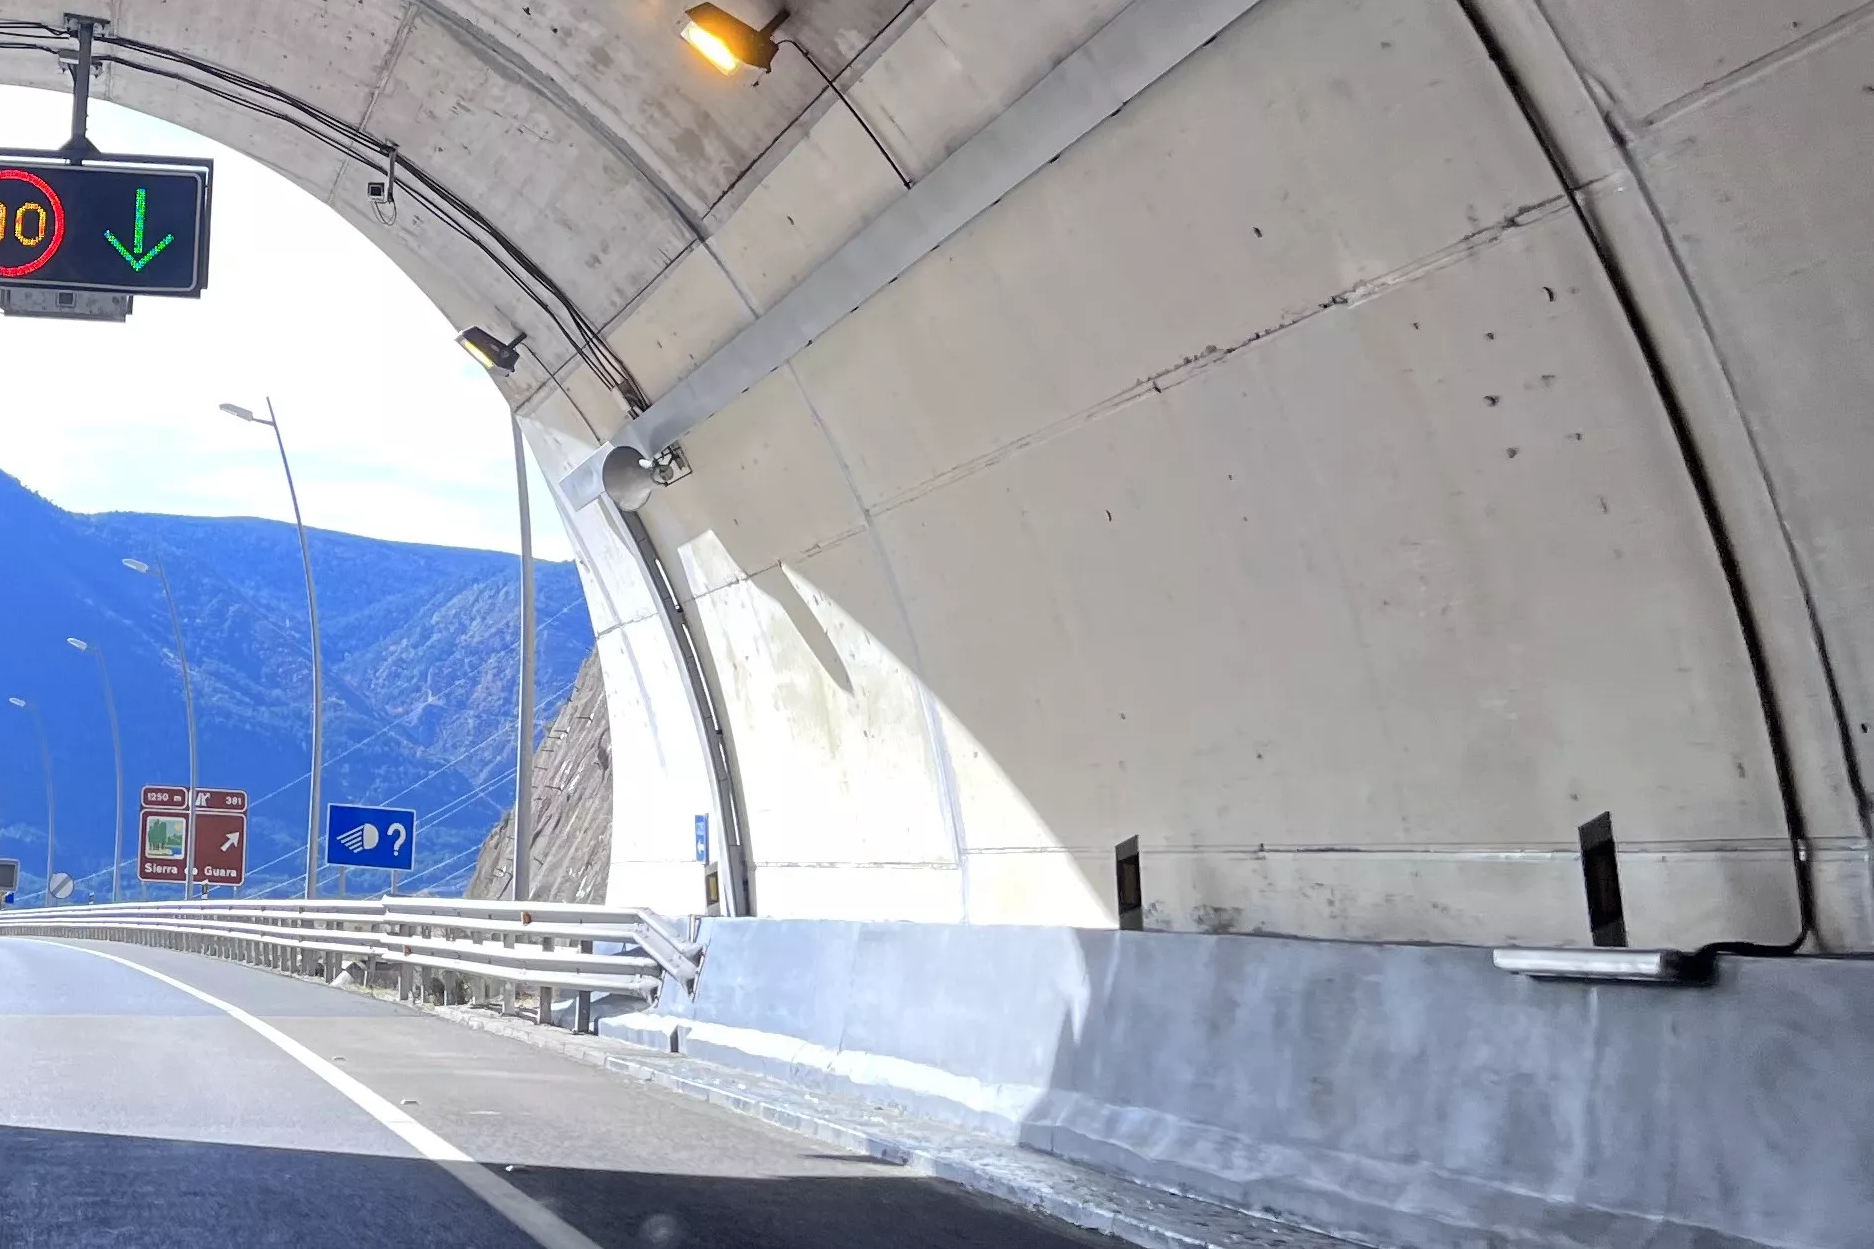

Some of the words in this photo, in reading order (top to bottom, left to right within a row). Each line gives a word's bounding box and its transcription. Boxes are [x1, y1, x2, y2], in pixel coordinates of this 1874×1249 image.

[147, 792, 169, 802] 1250
[225, 796, 242, 806] 381
[144, 862, 178, 874] Sierra
[204, 865, 237, 877] Guara
